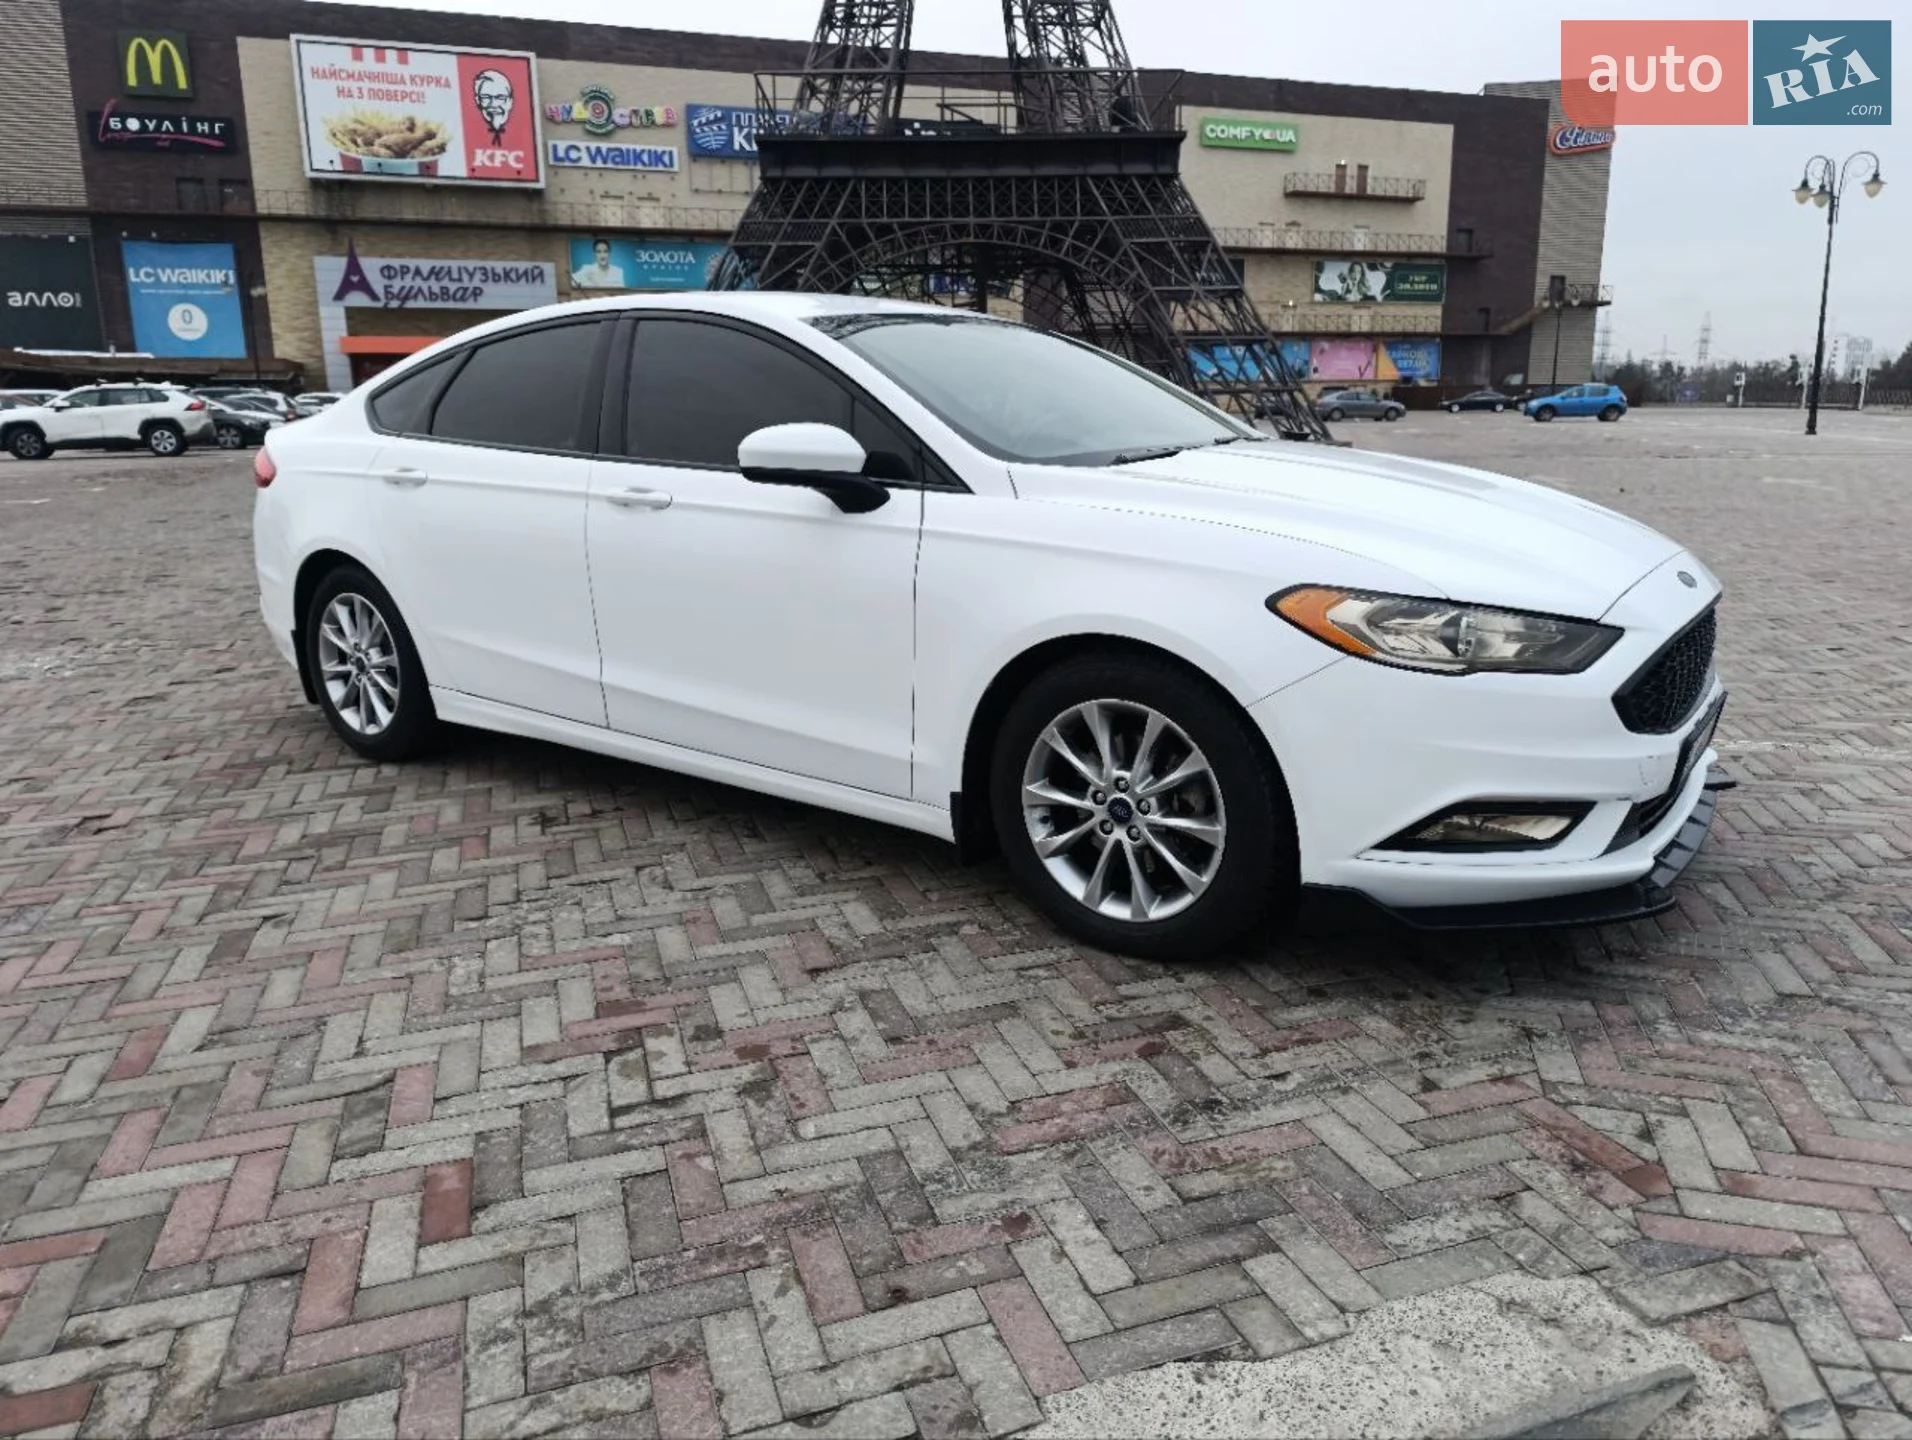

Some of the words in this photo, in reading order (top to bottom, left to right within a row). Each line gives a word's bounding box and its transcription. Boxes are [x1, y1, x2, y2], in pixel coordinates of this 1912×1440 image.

[310, 65, 407, 86] НАЙСМАЧНІША
[409, 74, 452, 89] КУРКА
[336, 86, 354, 99] НА
[356, 87, 365, 99] 3
[108, 117, 226, 135] БОУЛІНГ
[472, 149, 524, 168] KFC
[552, 144, 582, 163] LC
[635, 250, 696, 264] ЗОЛОТА
[128, 267, 157, 283] LC
[379, 264, 546, 285] ФРАНЦУЗЬКИЙ
